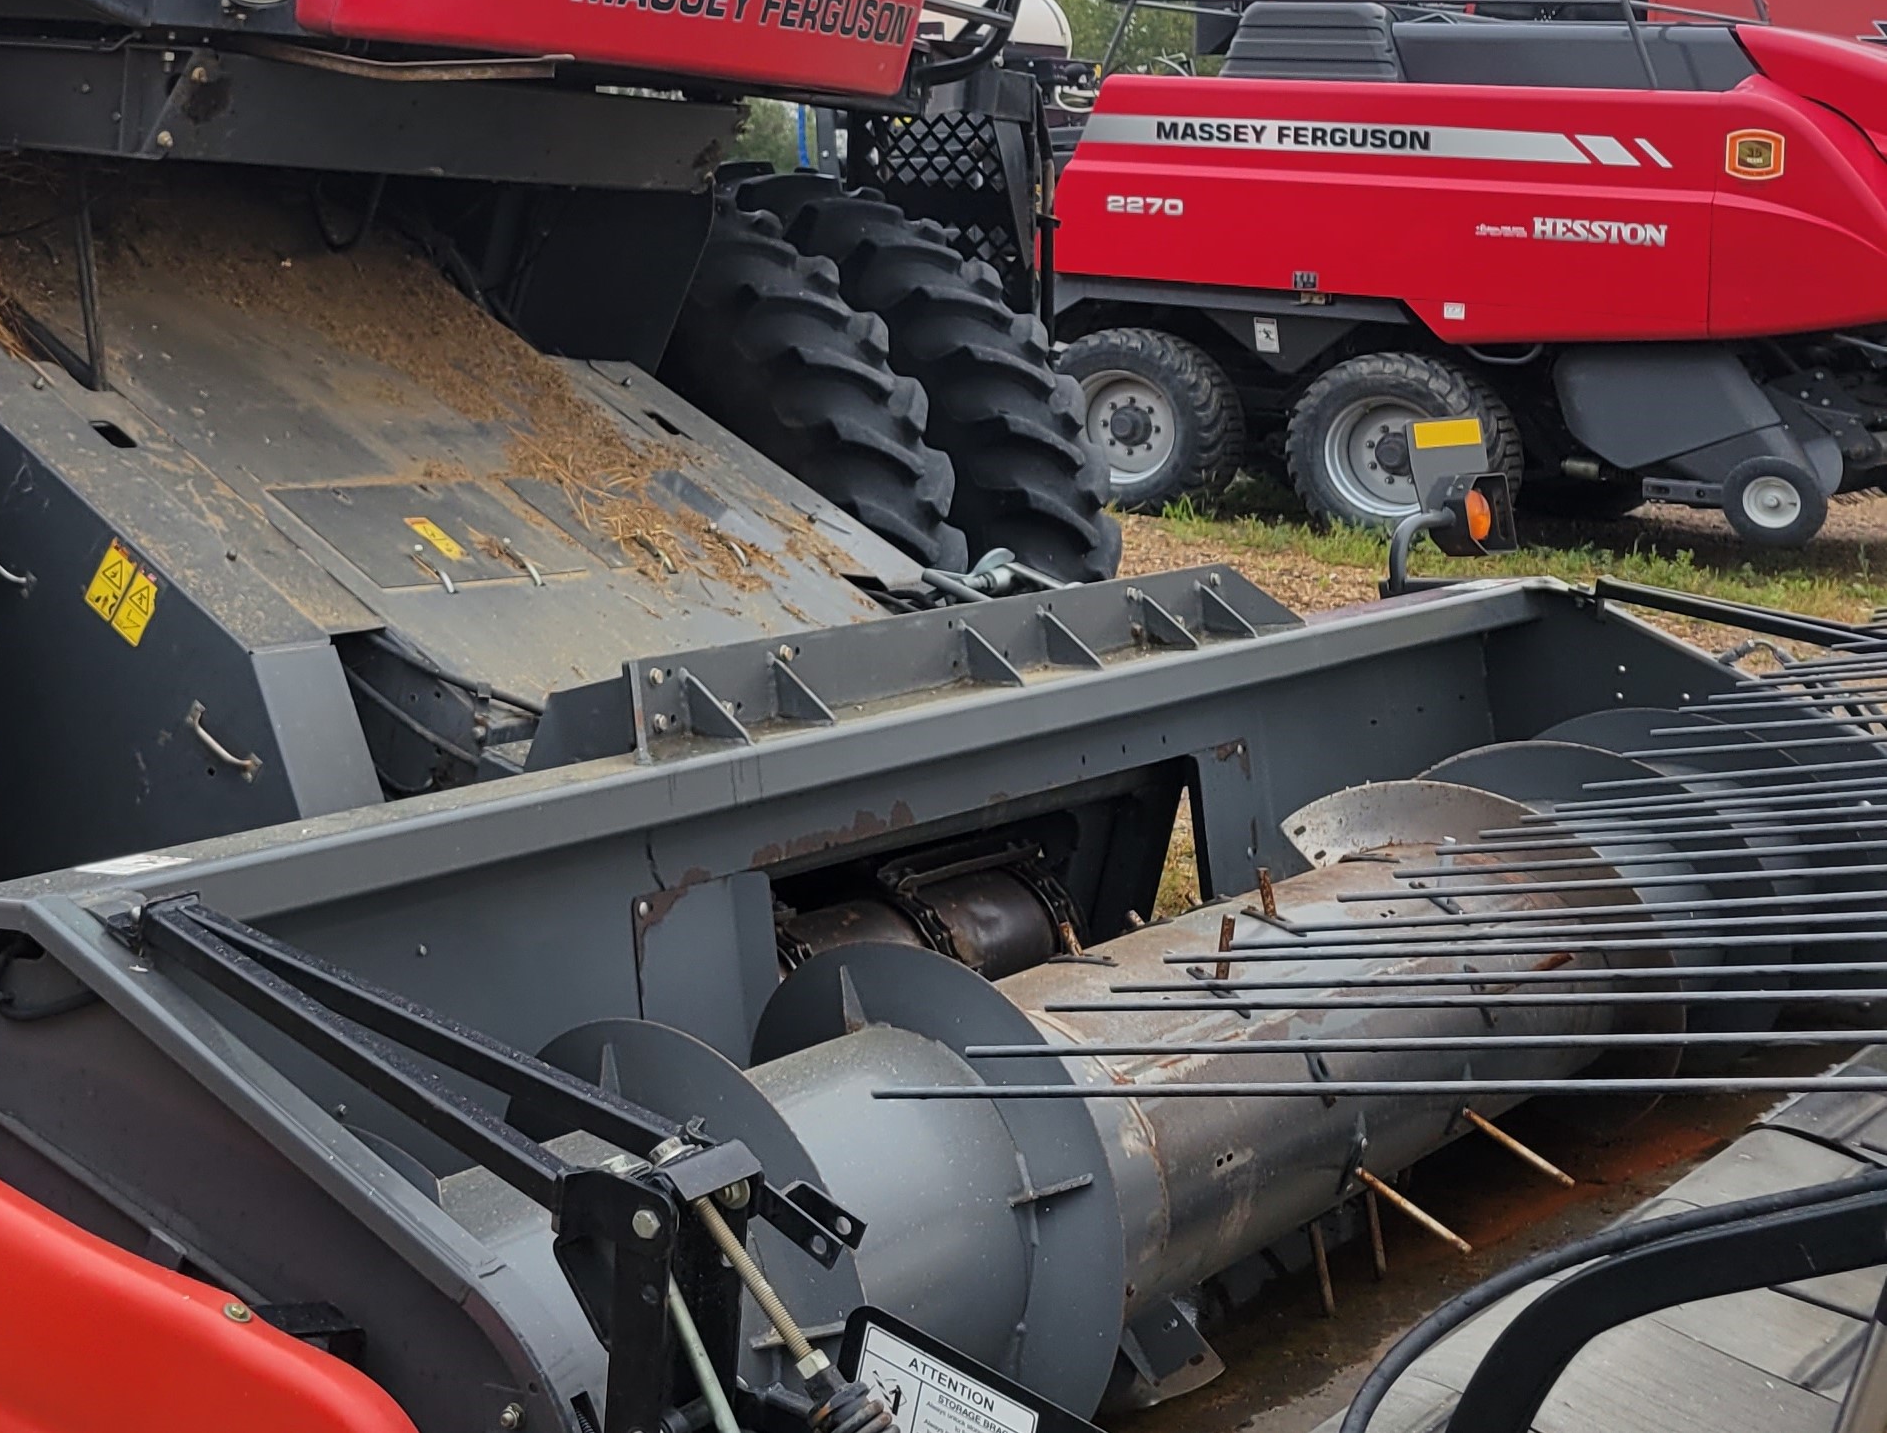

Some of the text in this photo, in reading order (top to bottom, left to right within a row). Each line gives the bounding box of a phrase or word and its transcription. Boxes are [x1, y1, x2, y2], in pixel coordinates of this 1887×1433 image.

[1155, 121, 1431, 151] MASSEY FERGUSON
[1106, 194, 1184, 216] 2270
[1532, 217, 1668, 247] HESSTON
[908, 1358, 995, 1413] ATTENTION
[937, 1394, 982, 1424] STORAGE
